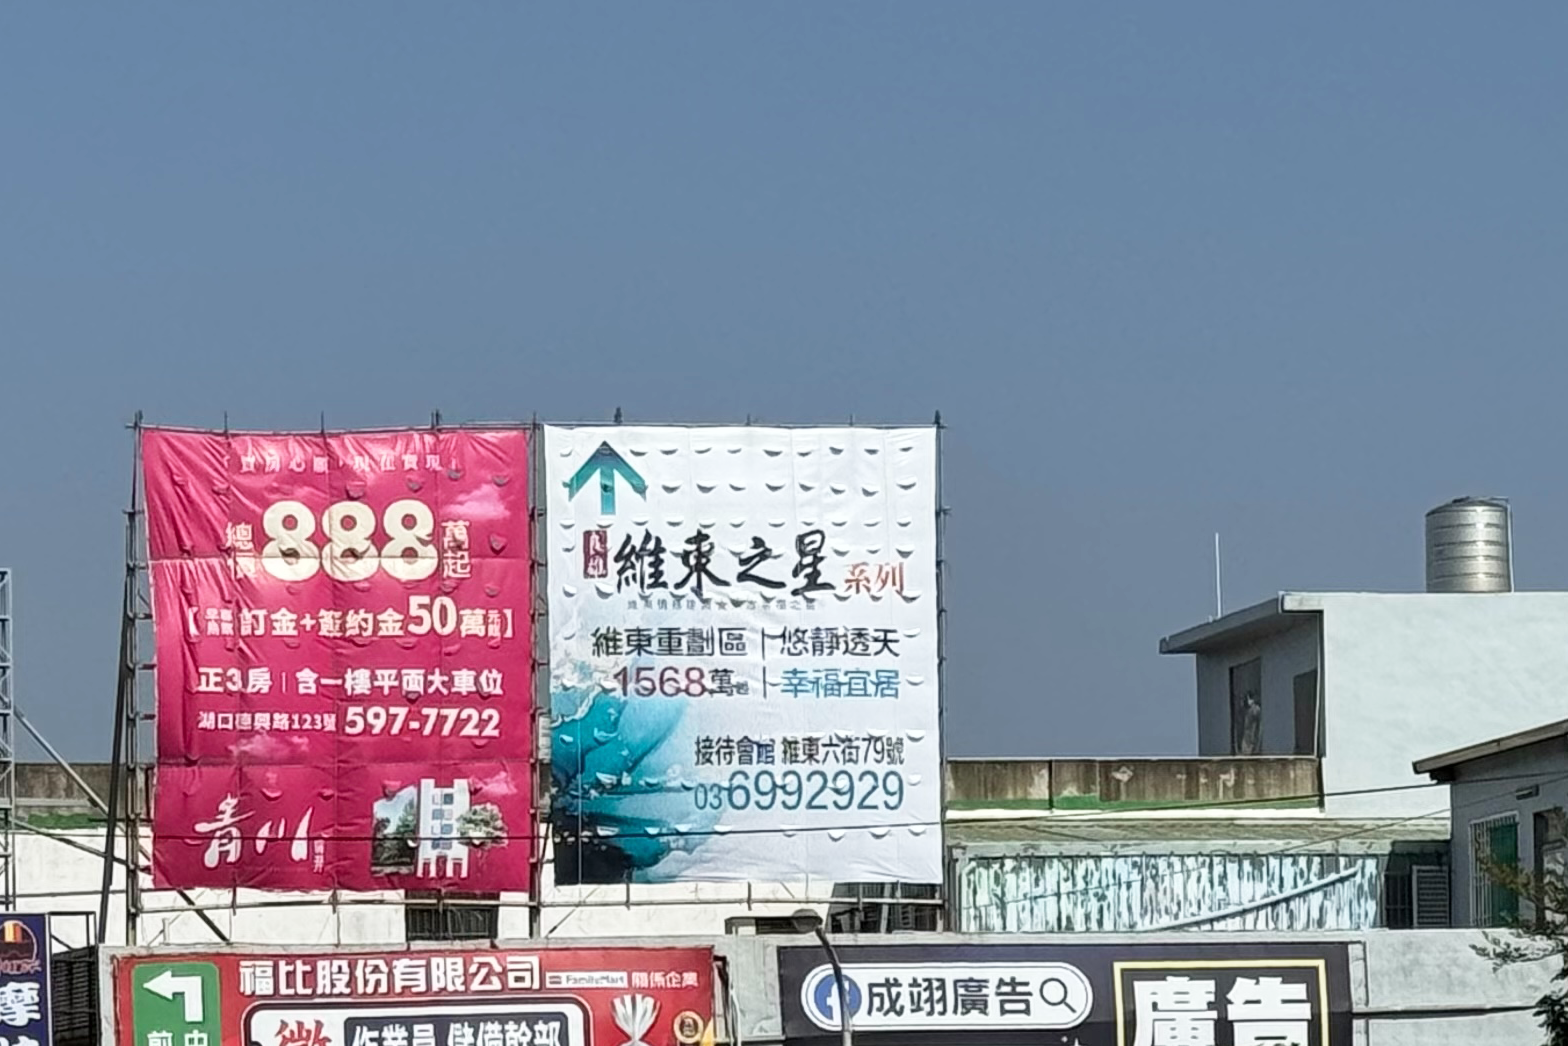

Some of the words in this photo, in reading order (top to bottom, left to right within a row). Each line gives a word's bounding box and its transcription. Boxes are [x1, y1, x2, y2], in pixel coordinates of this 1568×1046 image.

[262, 499, 440, 582] 888
[613, 528, 836, 597] 維東之星
[844, 561, 905, 595] 系列
[591, 627, 748, 657] 維東重劃區
[781, 626, 900, 657] 悠靜透天
[197, 666, 273, 694] 正3房
[781, 668, 899, 699] 幸福宜居
[344, 706, 501, 737] 597-7722
[694, 736, 776, 766] 接待會館
[240, 957, 542, 996] 福比股份有限公司
[866, 977, 1033, 1017] 成翊廣告
